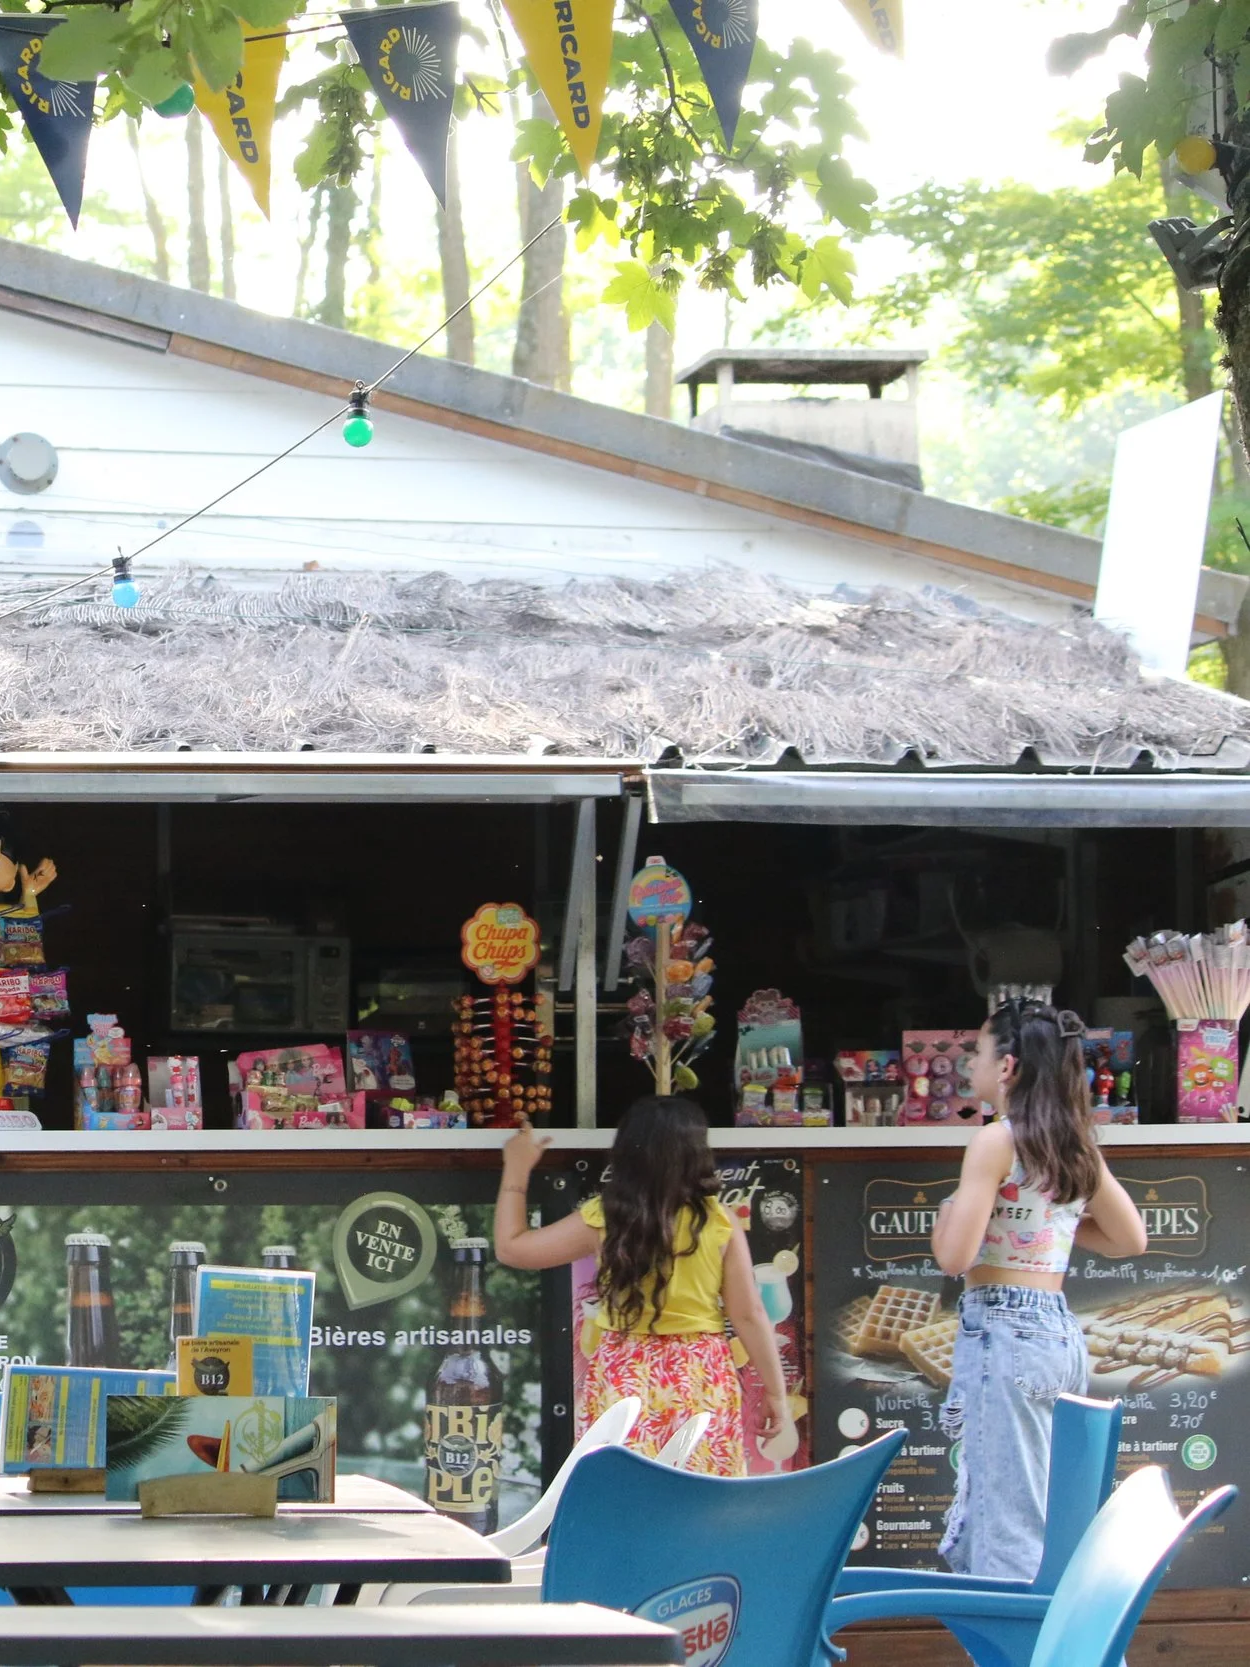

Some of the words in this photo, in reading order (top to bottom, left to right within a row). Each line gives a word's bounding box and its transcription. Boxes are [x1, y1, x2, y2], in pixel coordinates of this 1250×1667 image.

[379, 28, 411, 100] RICARD
[553, 0, 590, 129] RICARD
[17, 38, 50, 114] RICARD
[6, 926, 36, 935] HARIBO
[476, 924, 528, 944] Chupa
[473, 943, 527, 962] Chups
[16, 1048, 43, 1058] HARIBO
[311, 1063, 338, 1076] Barbie
[299, 1114, 325, 1127] Barbie
[376, 1220, 402, 1240] EN
[356, 1231, 415, 1261] VENTE
[366, 1252, 395, 1272] ICI
[309, 1326, 387, 1346] Bières
[394, 1325, 532, 1346] artisanales
[201, 1374, 225, 1385] B12
[1169, 1390, 1218, 1410] 3,20€
[876, 1417, 905, 1429] Sucre
[1122, 1415, 1138, 1425] cre
[909, 1444, 947, 1456] tartiner
[1133, 1440, 1141, 1452] à
[1142, 1441, 1179, 1452] tartiner
[445, 1452, 471, 1465] B12
[876, 1482, 905, 1494] Fruits
[876, 1519, 932, 1531] Gourmande
[657, 1588, 713, 1619] GLACES
